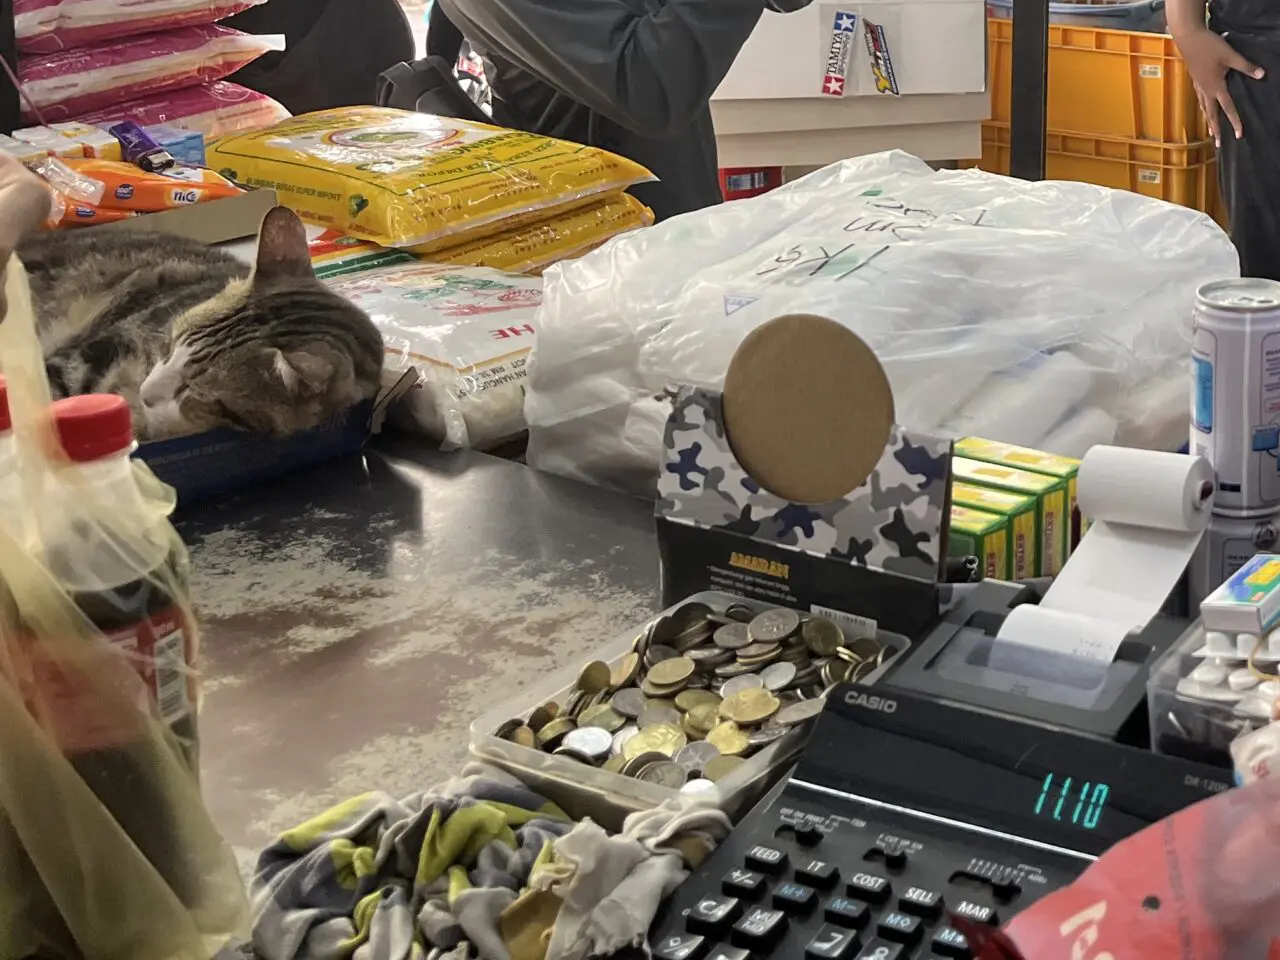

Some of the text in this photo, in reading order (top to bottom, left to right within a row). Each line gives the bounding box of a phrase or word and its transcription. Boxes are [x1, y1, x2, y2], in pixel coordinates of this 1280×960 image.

[827, 31, 843, 76] TAMIYA
[844, 690, 898, 714] CASIO
[750, 844, 781, 863] FEED
[807, 860, 827, 874] IT
[851, 873, 886, 890] COST
[904, 886, 934, 904] SELL
[957, 901, 991, 920] MAR
